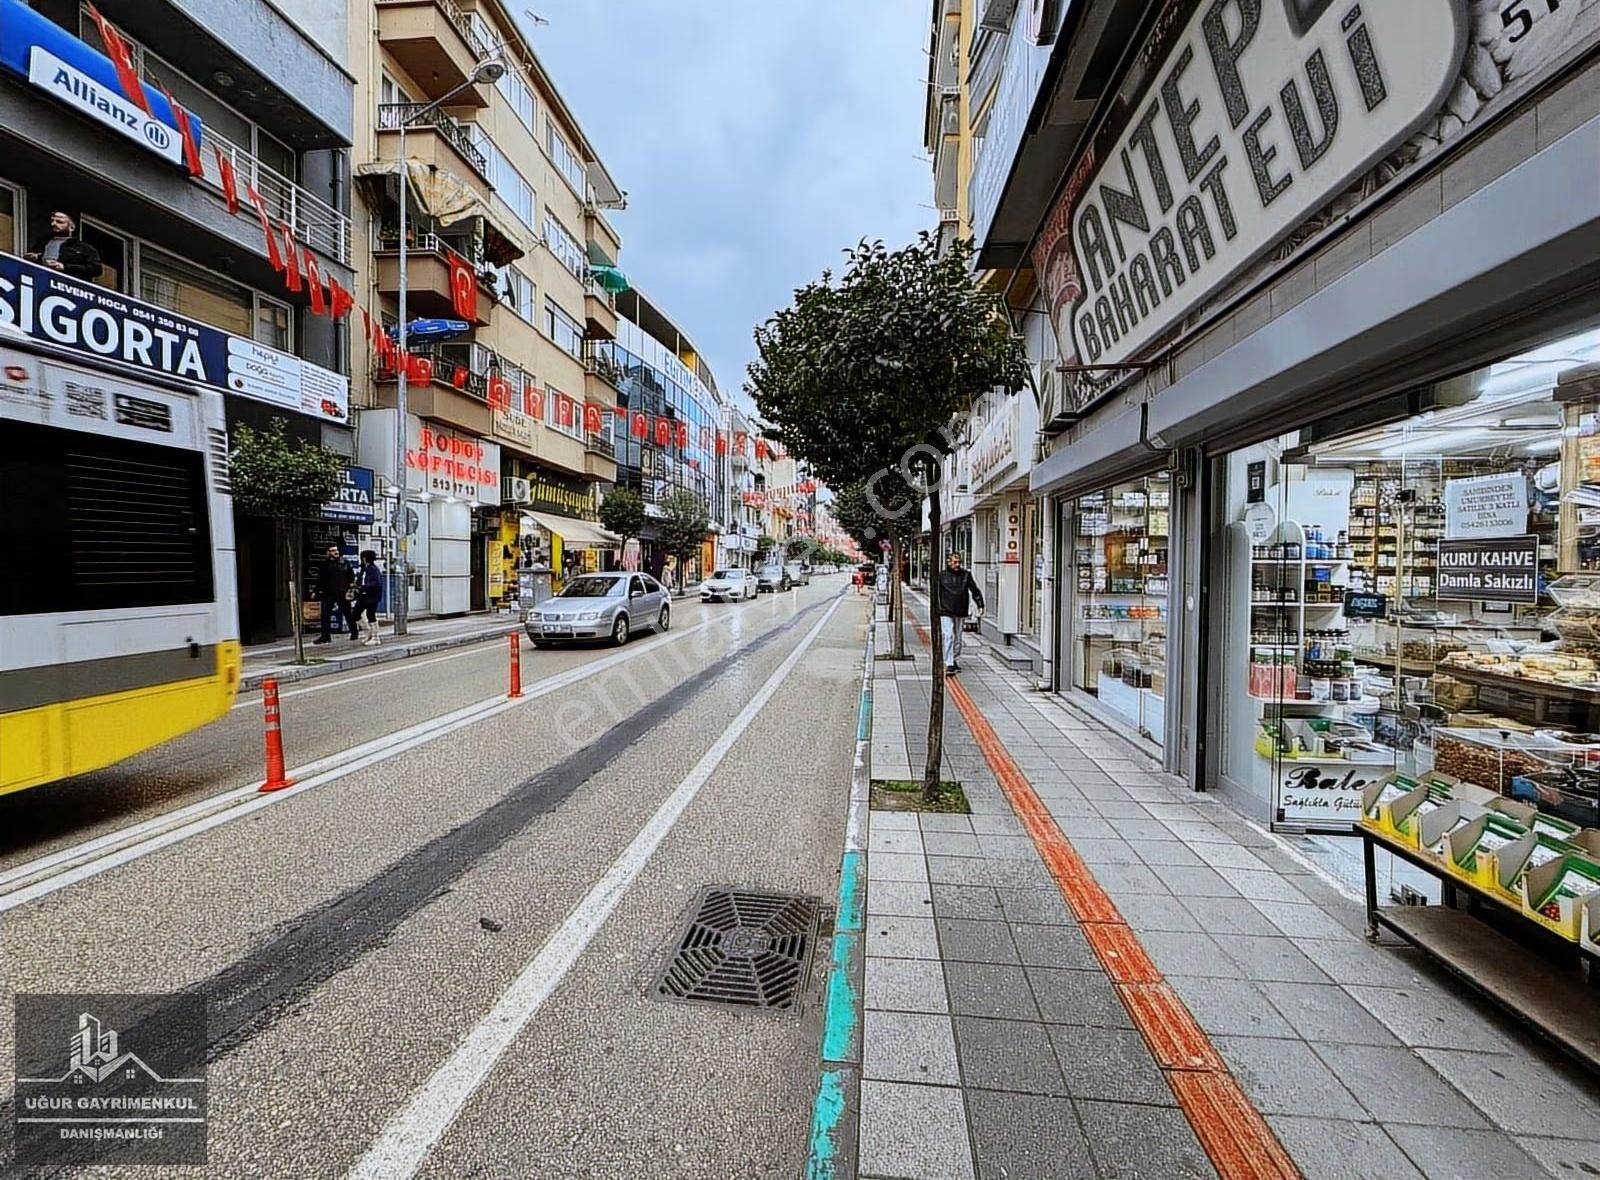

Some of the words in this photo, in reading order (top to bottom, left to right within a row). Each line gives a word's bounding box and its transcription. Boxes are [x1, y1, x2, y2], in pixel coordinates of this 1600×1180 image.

[54, 68, 138, 131] Allianz
[1077, 0, 1262, 292] ANTEP
[1080, 155, 1239, 362] BAHARAT
[50, 279, 95, 301] LEVENT
[98, 296, 129, 313] HOCA
[421, 427, 485, 462] RODOP
[1008, 502, 1018, 549] FOTO
[1440, 552, 1477, 566] KURU
[1481, 551, 1534, 566] KAHVE
[1440, 573, 1481, 588] Damla
[1484, 573, 1533, 590] Sakızlı
